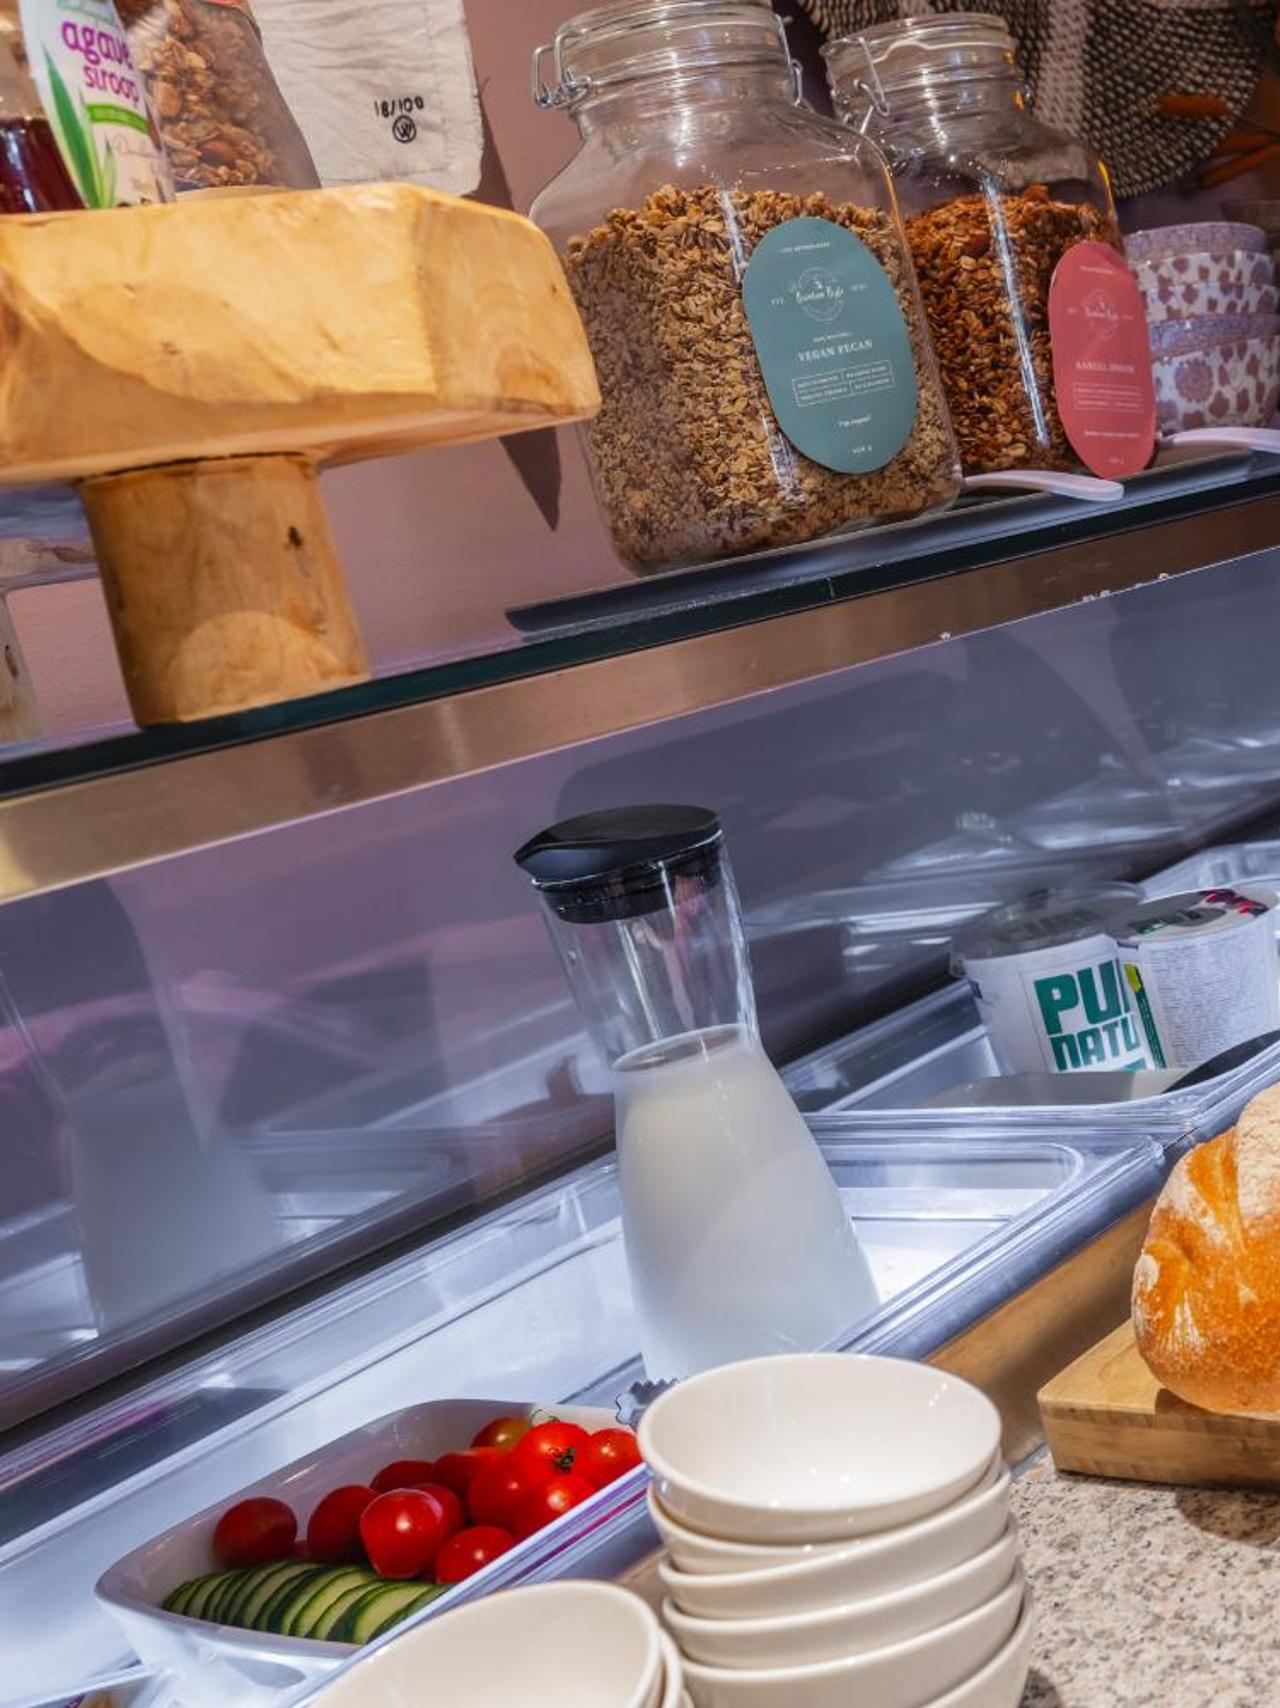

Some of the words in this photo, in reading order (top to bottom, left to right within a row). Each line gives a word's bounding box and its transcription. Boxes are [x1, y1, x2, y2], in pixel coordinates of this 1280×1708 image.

[83, 65, 139, 109] siroop
[798, 348, 836, 361] VEGAN
[838, 339, 873, 354] PECAN
[1034, 958, 1131, 1036] PU
